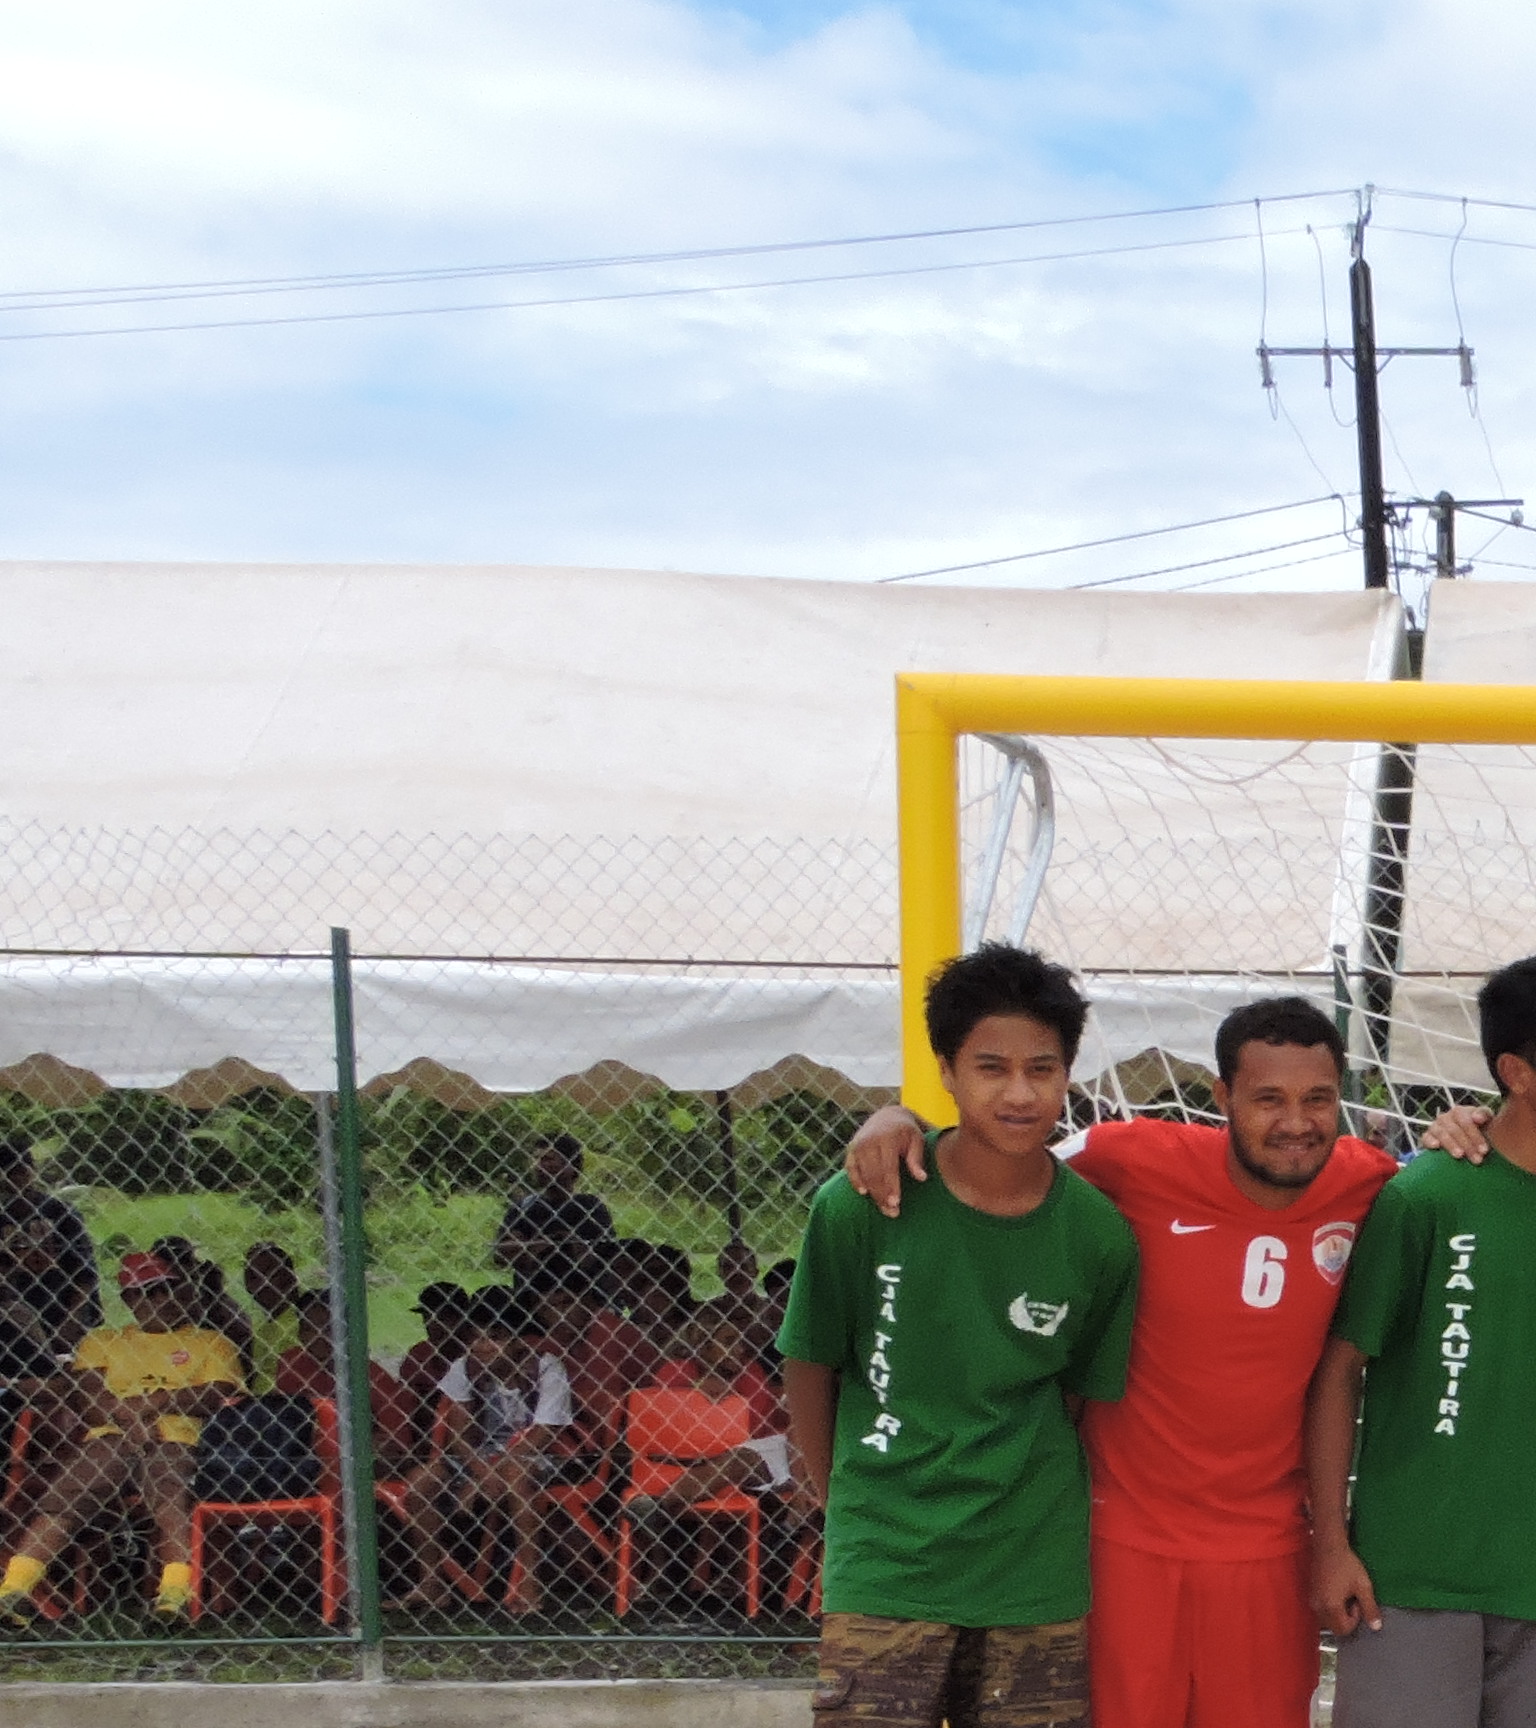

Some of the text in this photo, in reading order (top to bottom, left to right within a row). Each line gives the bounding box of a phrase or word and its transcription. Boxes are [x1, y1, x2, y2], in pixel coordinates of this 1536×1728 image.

[861, 1263, 903, 1453] CJA TAUTRA
[1241, 1235, 1289, 1309] 6
[1433, 1233, 1476, 1436] CJA TAUTIRA
